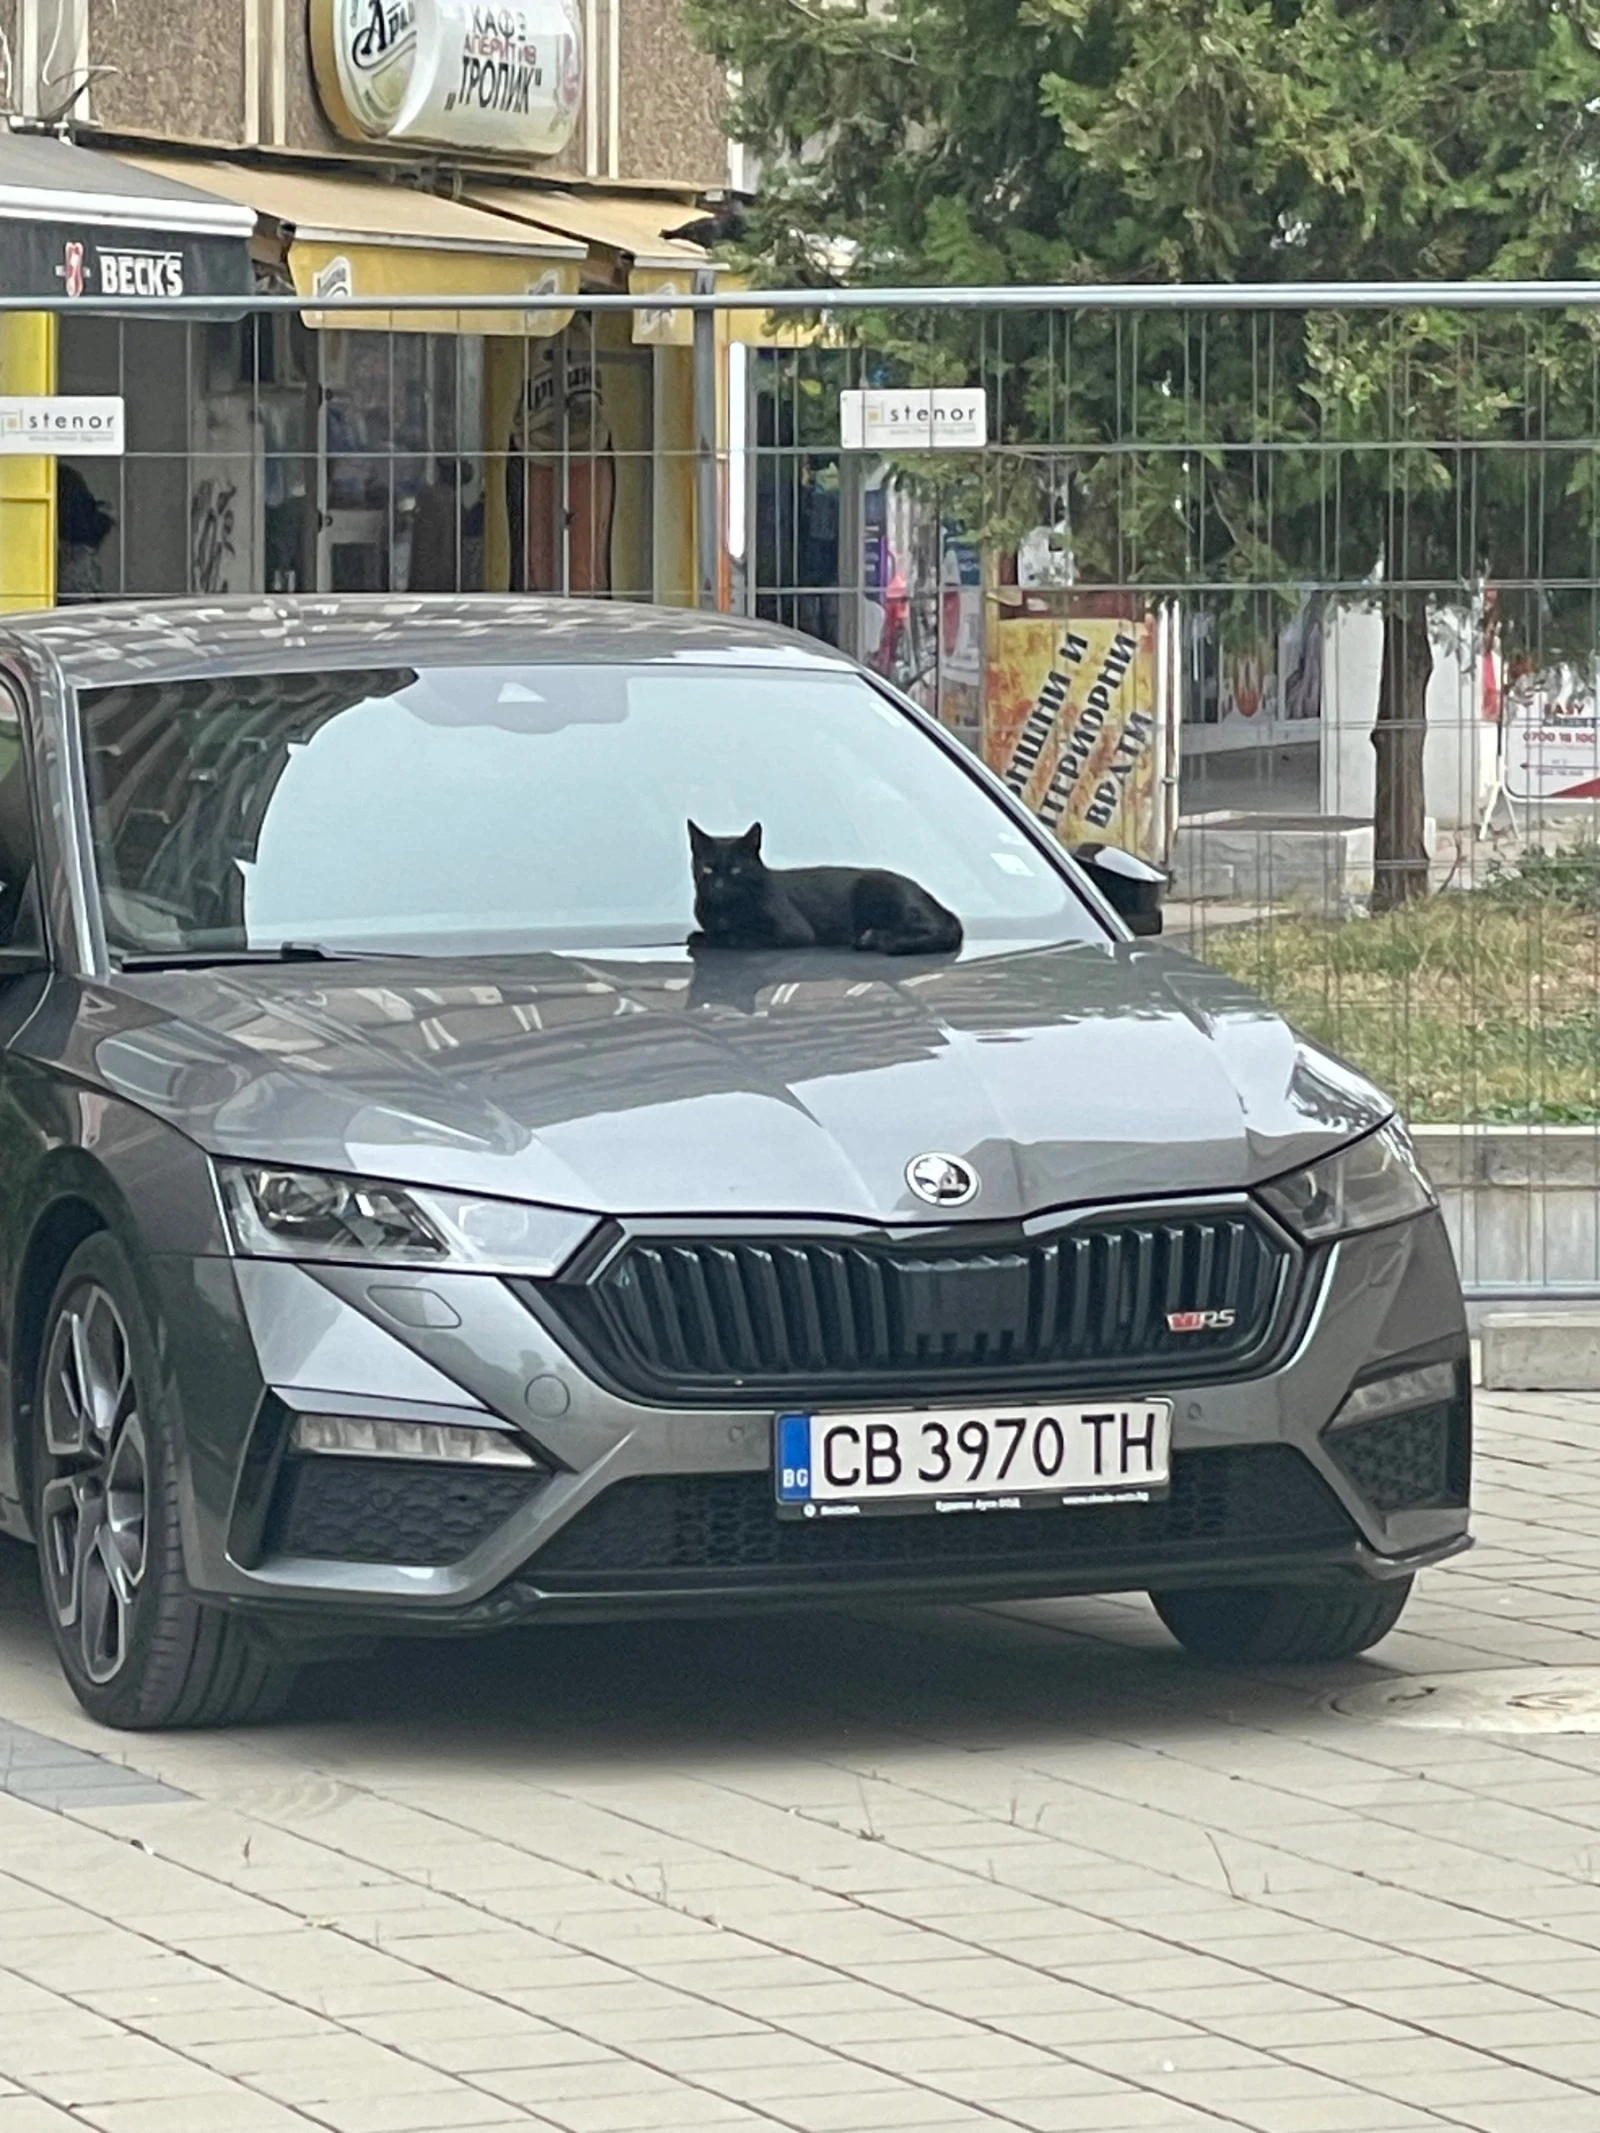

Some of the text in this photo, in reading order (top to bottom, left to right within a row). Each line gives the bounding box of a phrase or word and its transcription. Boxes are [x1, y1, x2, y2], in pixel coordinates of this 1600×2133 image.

[29, 412, 115, 428] stenor
[890, 405, 976, 422] stenor
[1059, 632, 1088, 664] И
[1085, 711, 1154, 829] ВРАТИ
[823, 1412, 1155, 1487] CB 3970 TH
[782, 1468, 809, 1488] BG
